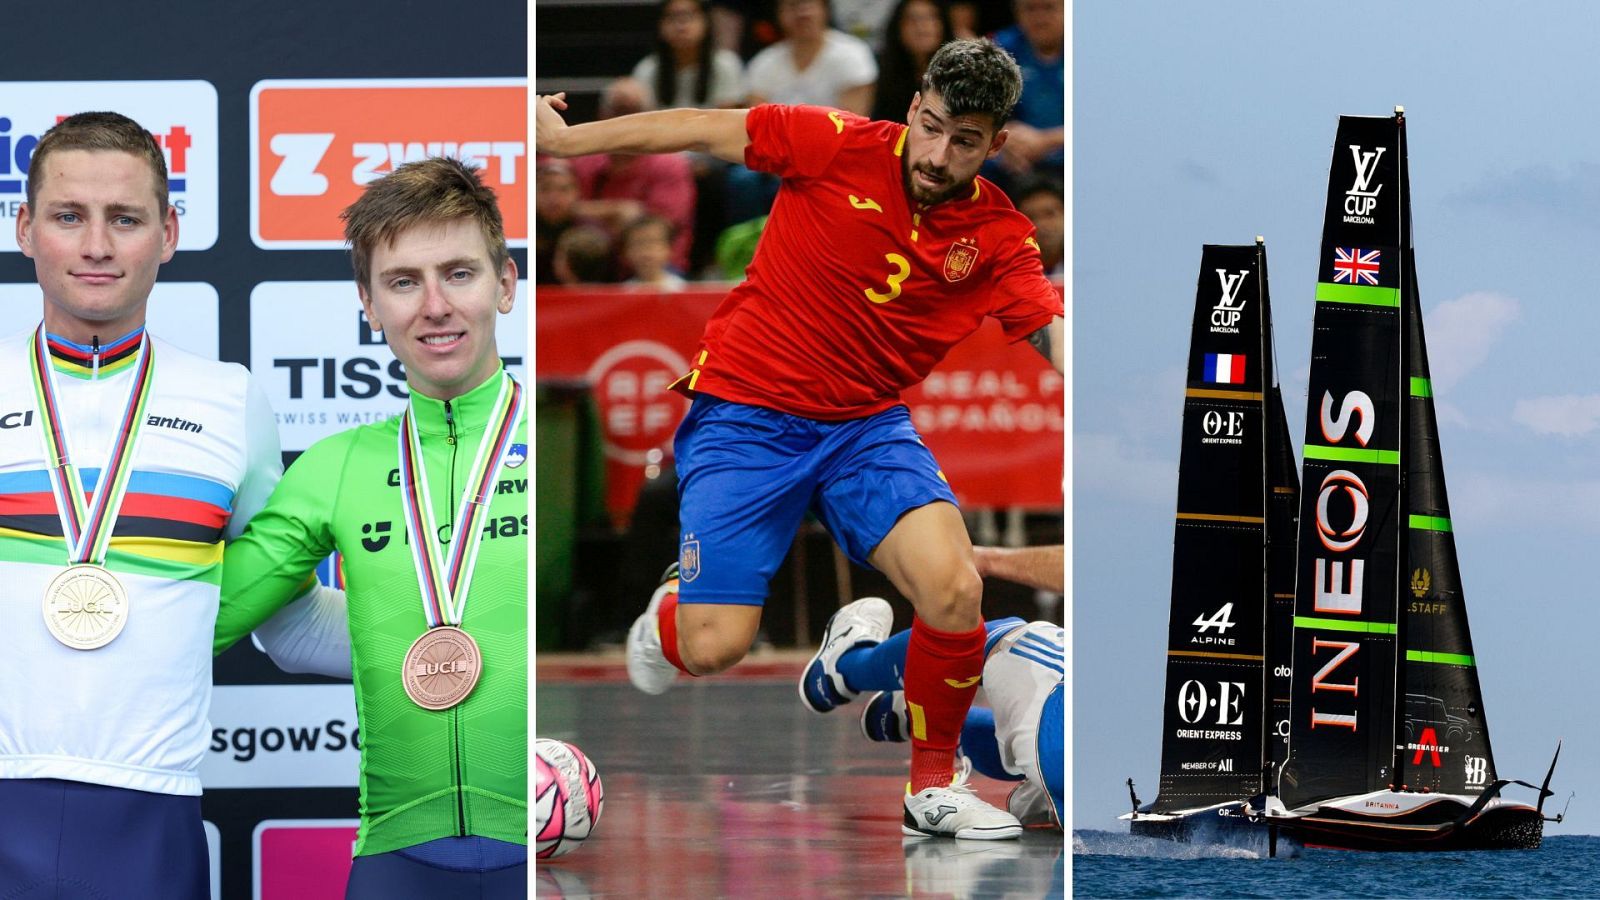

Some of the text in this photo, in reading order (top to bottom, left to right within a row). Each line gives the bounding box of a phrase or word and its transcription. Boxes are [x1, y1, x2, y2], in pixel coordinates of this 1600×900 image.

[1344, 195, 1377, 216] CUP
[1343, 215, 1375, 225] BARCELONA
[863, 252, 911, 304] 3
[1211, 310, 1241, 327] CUP
[1210, 326, 1240, 334] BARCELONA
[922, 370, 1030, 399] REAL
[274, 412, 328, 425] SWISS
[607, 403, 672, 435] EF
[910, 399, 1064, 433] SPAÑOL
[147, 413, 203, 434] antini
[1311, 389, 1376, 734] INEOS
[1407, 601, 1447, 615] STAFF
[1190, 636, 1236, 646] ALPINE
[426, 660, 456, 675] UCI
[1176, 728, 1242, 741] ORIENT EXPRESS
[1407, 742, 1450, 754] GRENADIER
[1181, 762, 1206, 770] MEMBER
[1217, 758, 1233, 772] All
[1365, 801, 1400, 810] BRITANNIA
